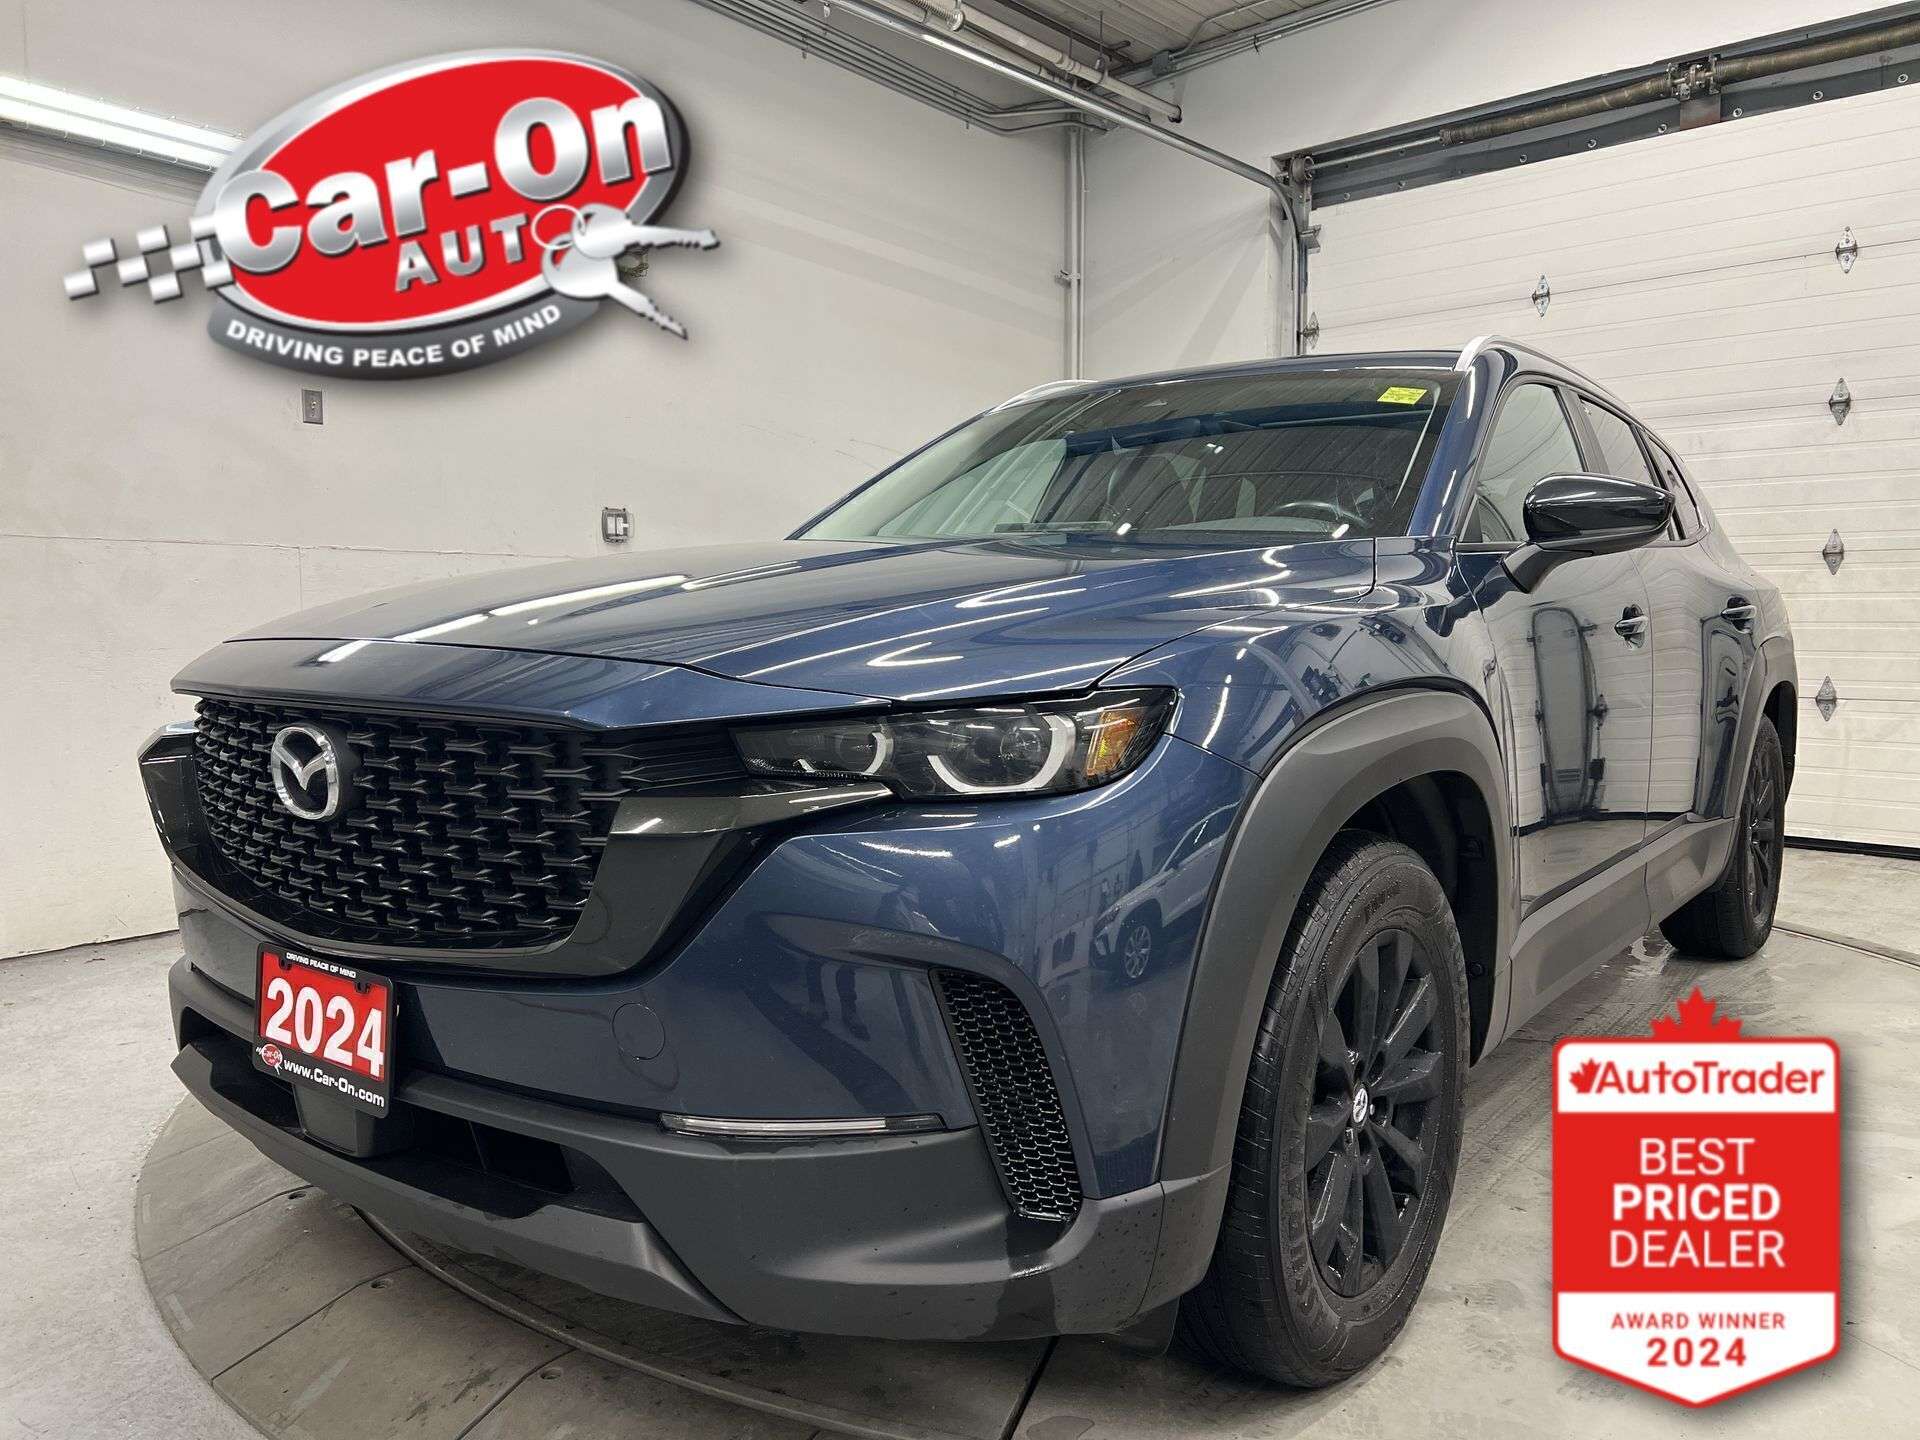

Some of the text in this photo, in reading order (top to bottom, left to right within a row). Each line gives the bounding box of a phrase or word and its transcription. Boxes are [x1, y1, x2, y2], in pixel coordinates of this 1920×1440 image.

[286, 952, 357, 979] DRIVING PEACE OF MIND
[265, 977, 385, 1077] 2024
[284, 1059, 385, 1107] www.Car-On.com
